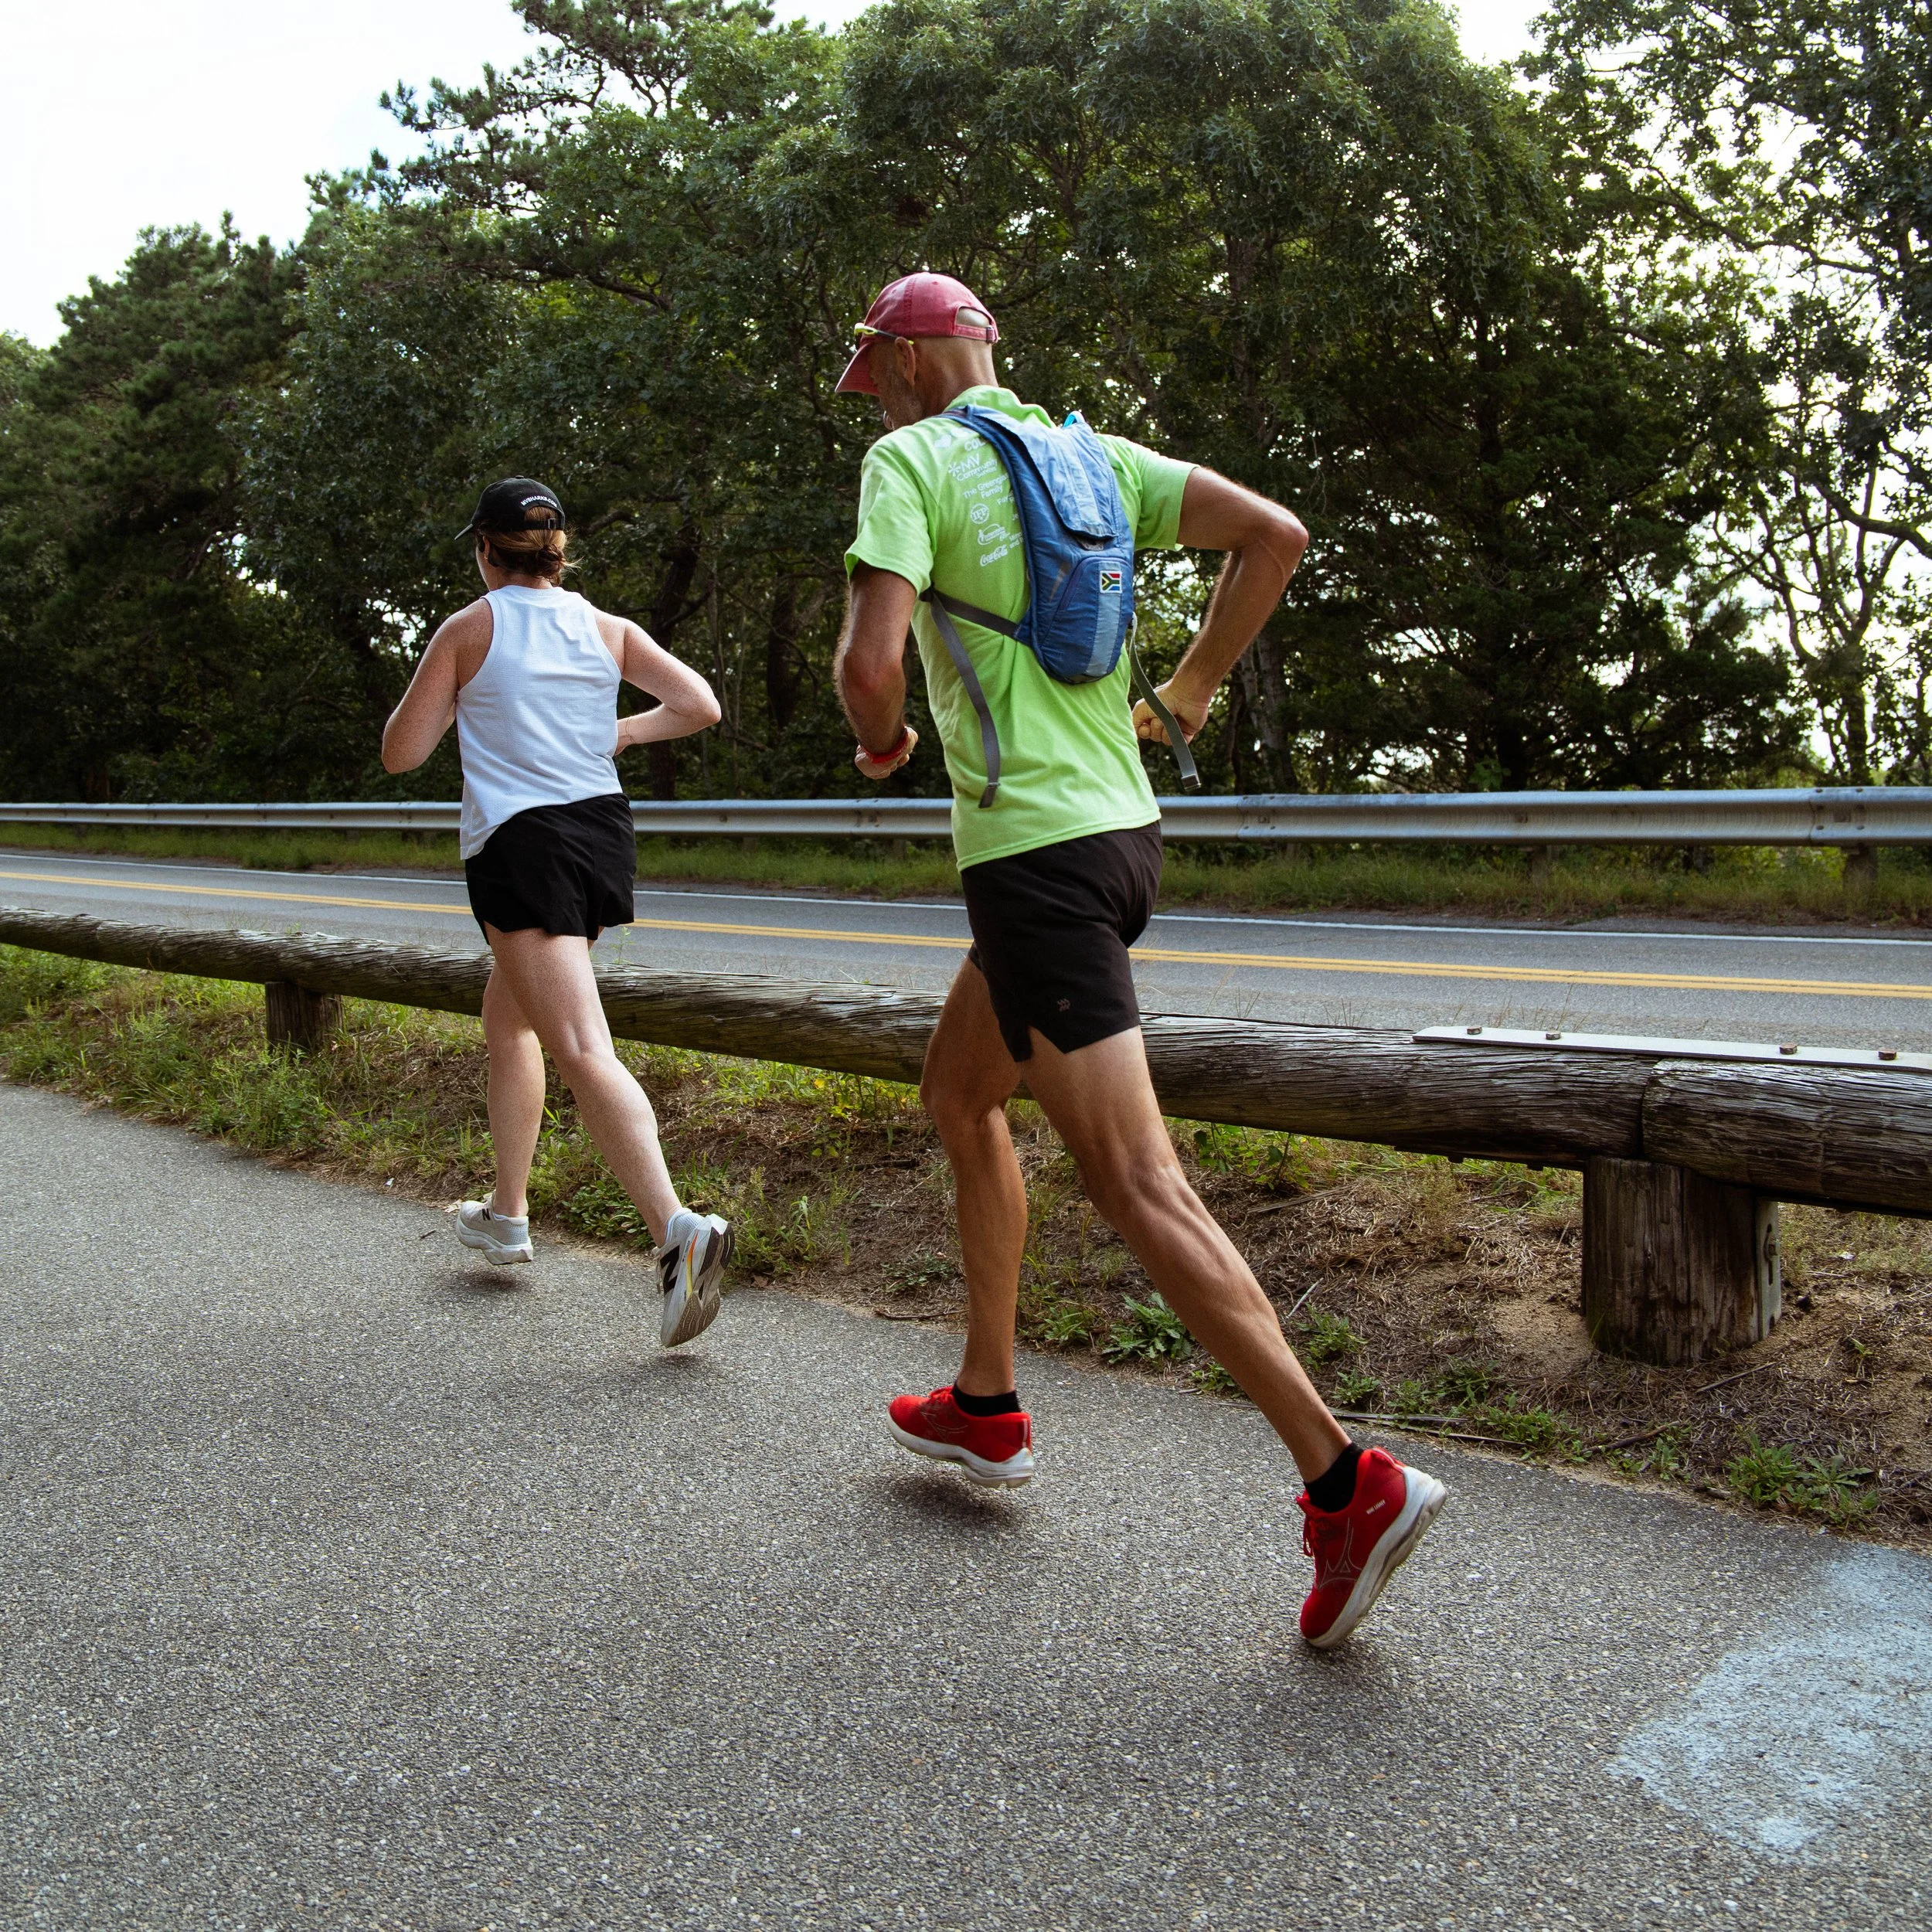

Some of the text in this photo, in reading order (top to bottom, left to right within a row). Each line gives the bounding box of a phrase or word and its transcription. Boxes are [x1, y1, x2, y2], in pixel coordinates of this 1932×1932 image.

[960, 454, 980, 472] MV
[963, 488, 977, 498] The
[981, 485, 1003, 498] Family
